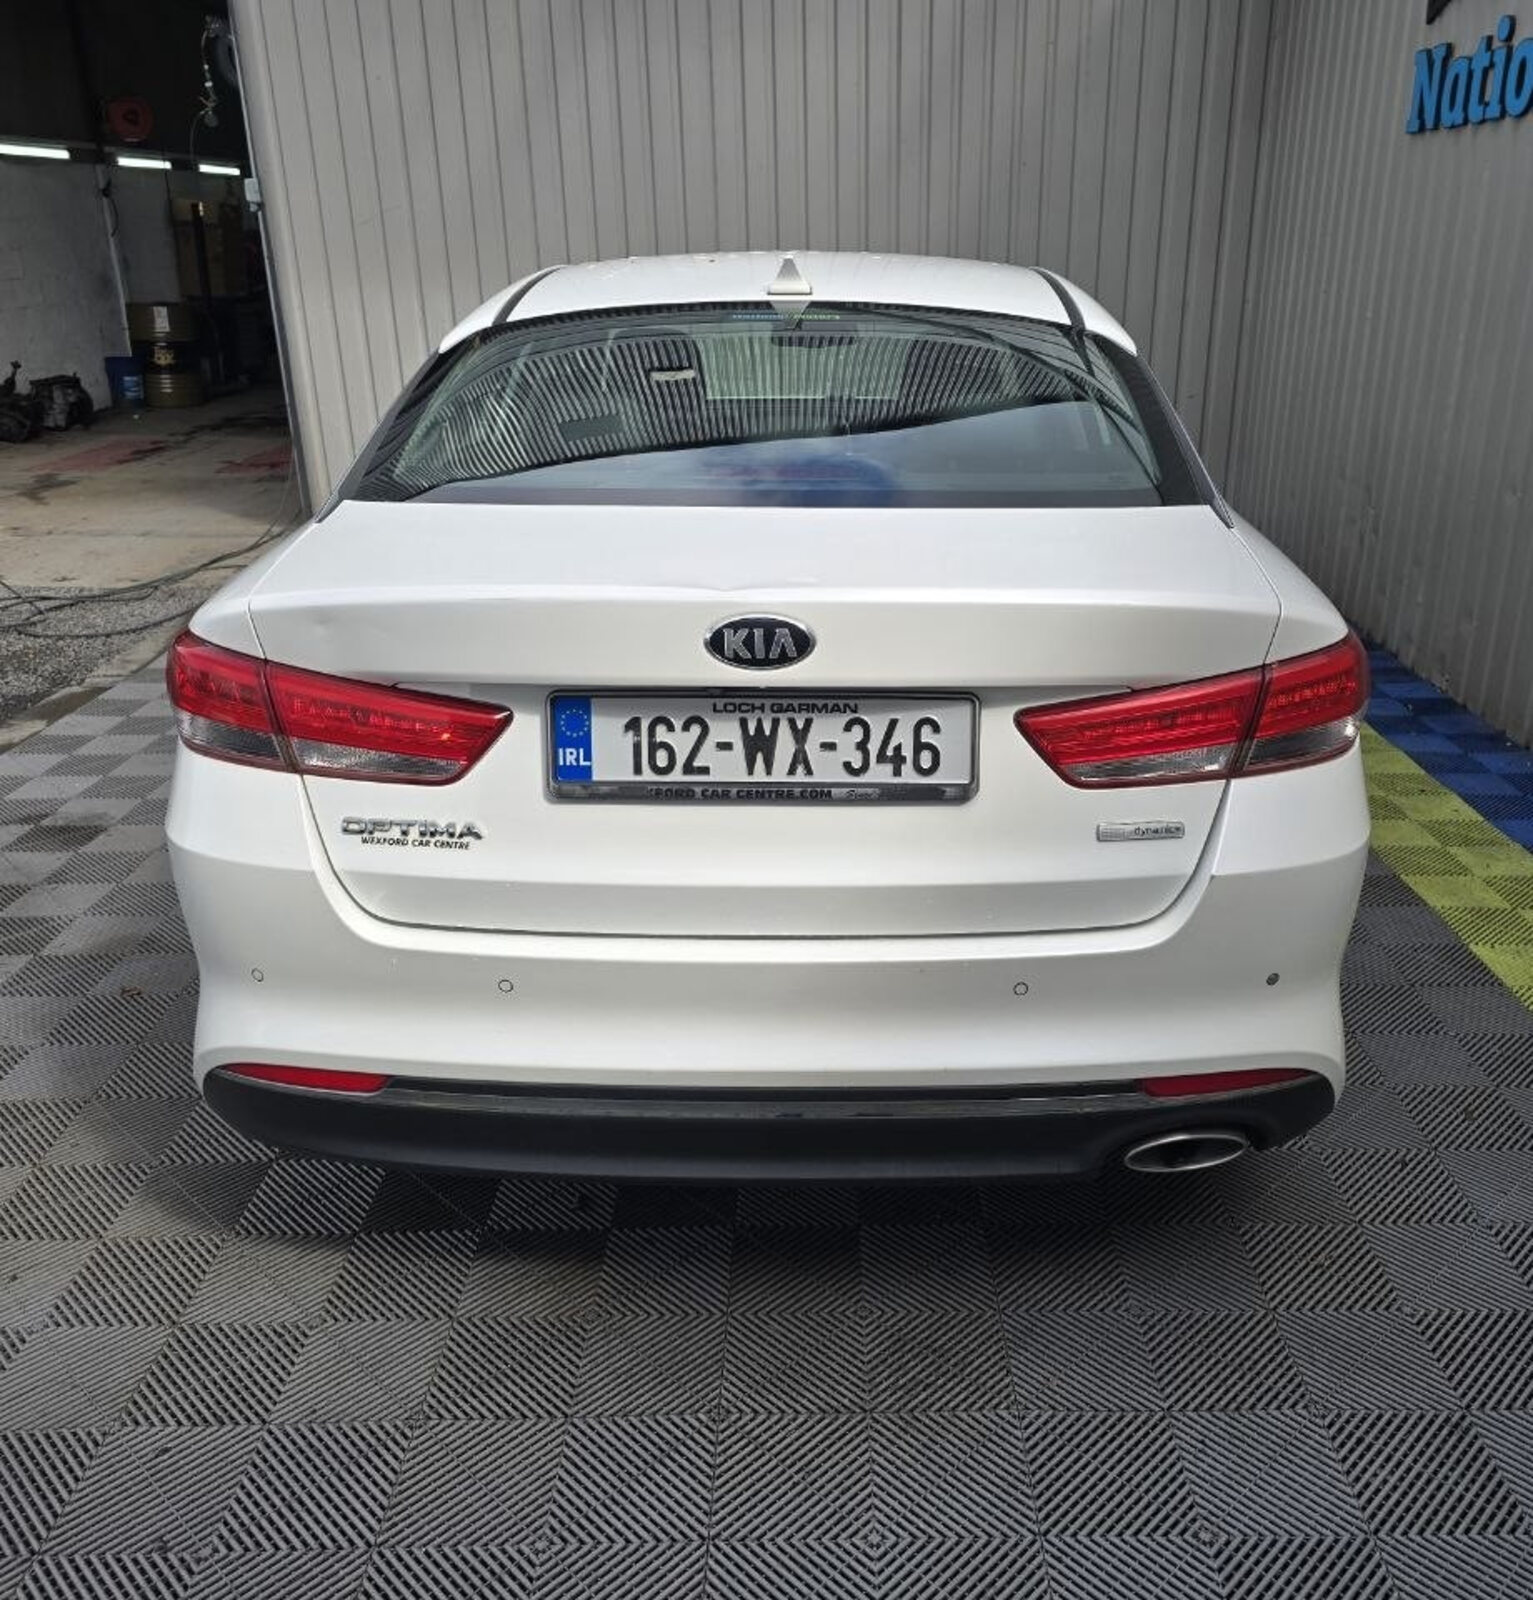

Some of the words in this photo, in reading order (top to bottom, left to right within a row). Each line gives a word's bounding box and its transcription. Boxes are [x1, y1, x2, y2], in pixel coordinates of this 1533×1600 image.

[722, 627, 798, 659] KIA
[712, 702, 765, 714] LOCH
[769, 702, 858, 714] GARMAN
[623, 715, 942, 777] 162-WX-346
[559, 748, 592, 766] IRL
[701, 788, 732, 799] CAR
[736, 788, 832, 800] CENTRE.COM
[341, 816, 483, 840] OPTIMA
[361, 836, 408, 846] WEXFORD
[412, 839, 430, 847] CAR
[434, 840, 470, 850] CENTRE
